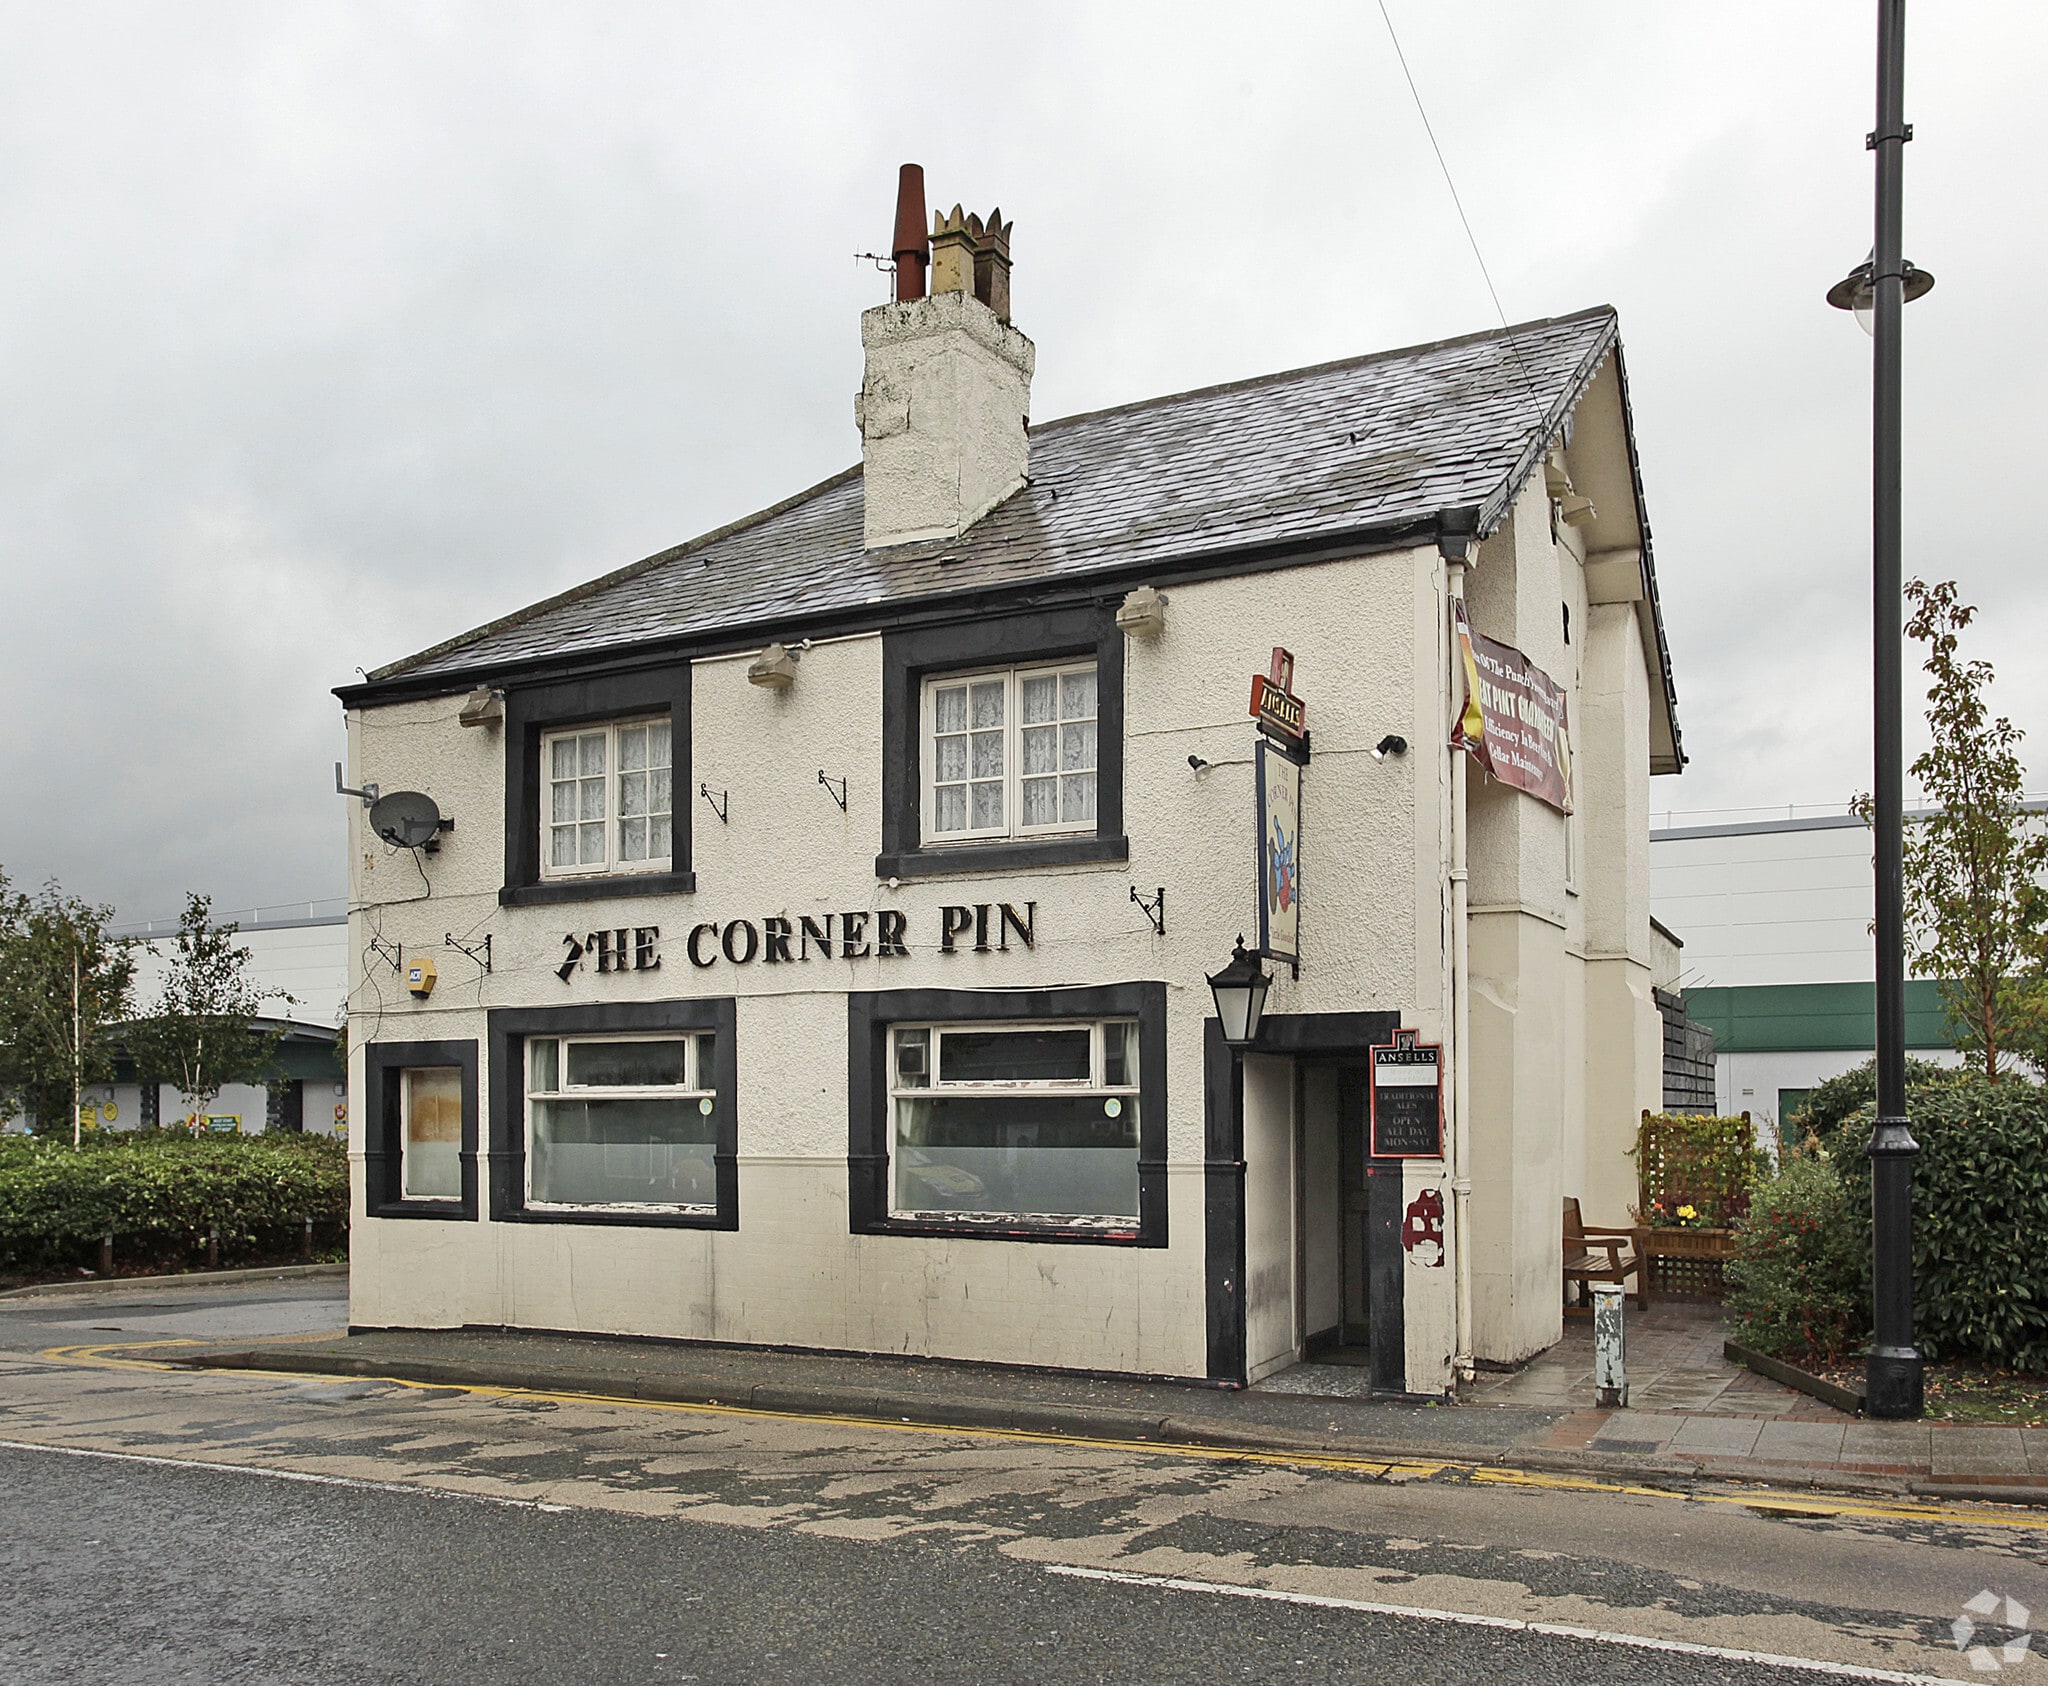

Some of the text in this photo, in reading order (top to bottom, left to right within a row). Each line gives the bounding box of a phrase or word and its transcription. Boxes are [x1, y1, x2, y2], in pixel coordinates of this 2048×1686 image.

[1489, 658, 1503, 678] The
[1505, 665, 1530, 687] Punch
[1261, 687, 1301, 727] ANSELLS
[1492, 685, 1516, 719] PINT
[1484, 714, 1520, 748] Efficiency
[1488, 742, 1510, 765] Cellar
[1277, 762, 1289, 782] THE
[554, 901, 1037, 985] THE CORNER PIN
[1379, 1053, 1435, 1062] ANSELLS
[1380, 1092, 1433, 1100] TRADITIONAL
[1396, 1102, 1417, 1110] ALES
[1393, 1116, 1420, 1125] OPEN
[1387, 1127, 1428, 1136] ALL DAY
[1384, 1138, 1430, 1147] MON-SAT
